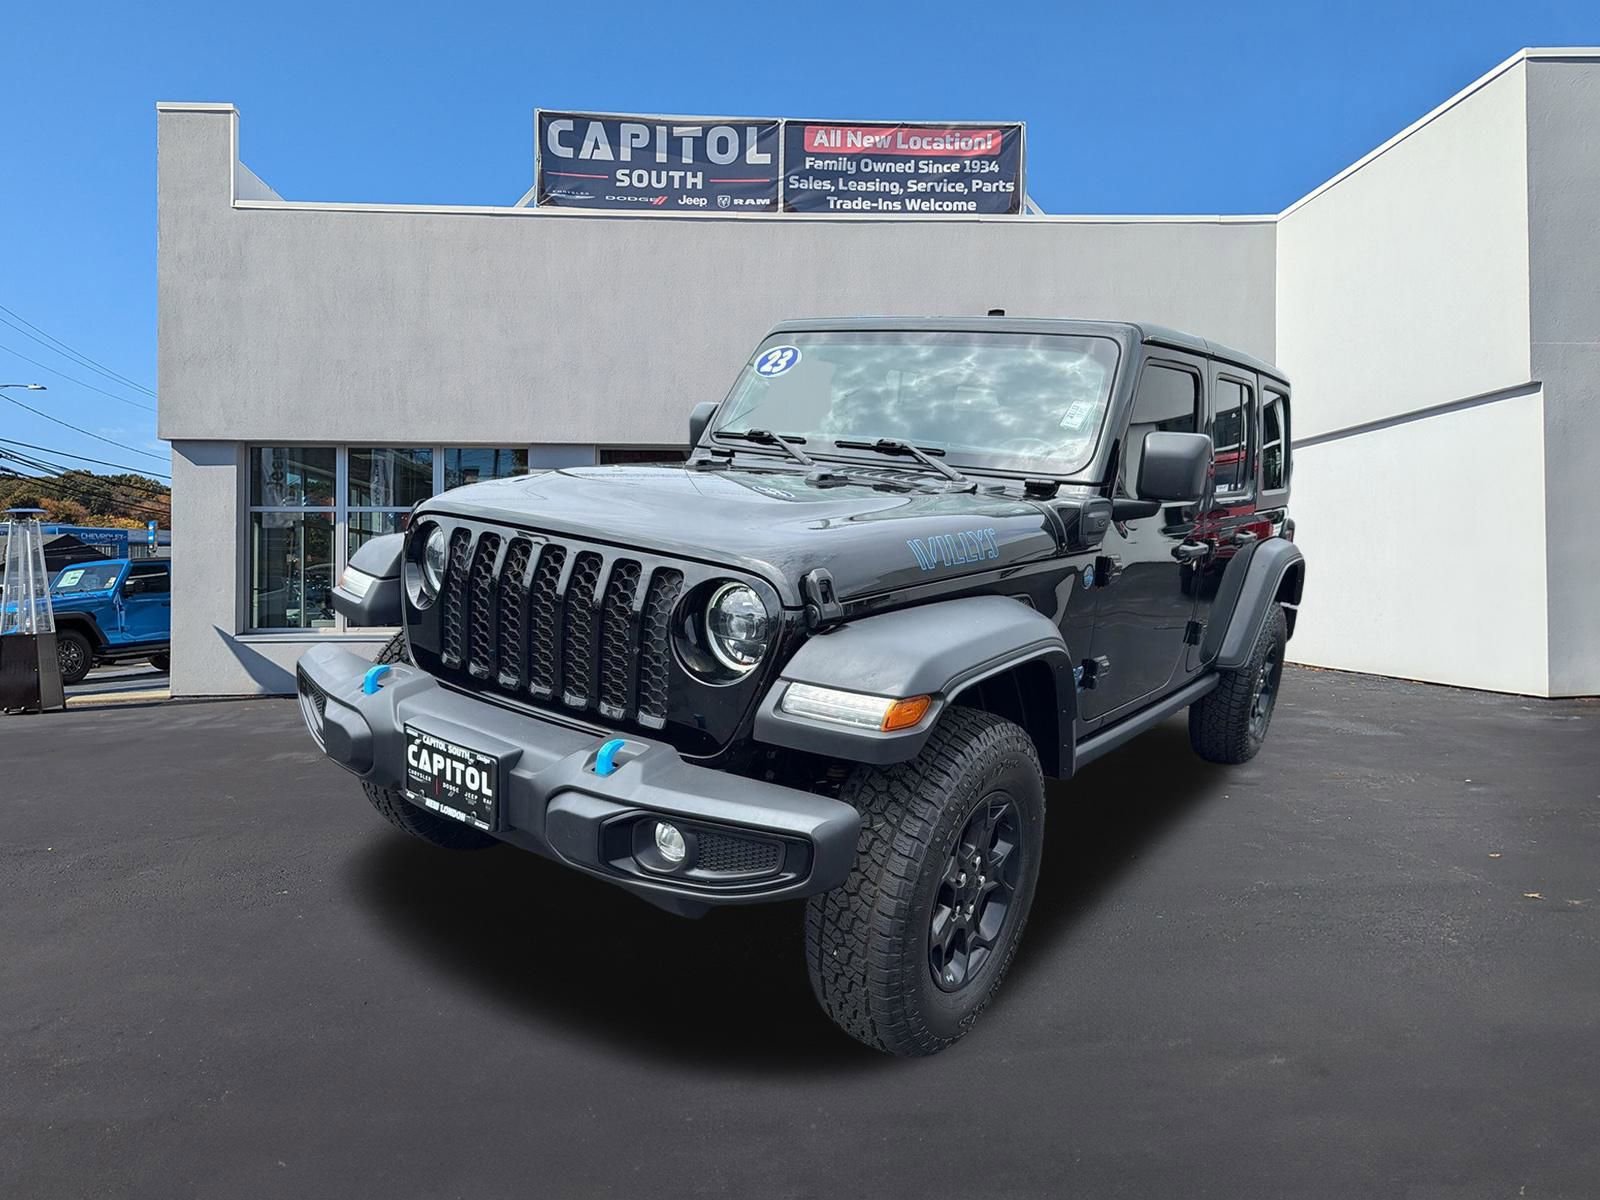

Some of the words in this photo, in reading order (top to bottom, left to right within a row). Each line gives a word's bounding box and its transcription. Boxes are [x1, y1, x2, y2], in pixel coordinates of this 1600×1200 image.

[547, 119, 772, 165] CAPITOL
[813, 129, 841, 147] All
[847, 131, 893, 149] New
[896, 133, 993, 151] Location!
[805, 157, 857, 174] Family
[860, 158, 915, 173] Owned
[918, 159, 961, 174] Since
[963, 160, 1000, 173] 1934
[615, 168, 703, 189] SOUTH
[788, 176, 836, 192] Sales,
[838, 178, 904, 195] Leasing,
[906, 179, 968, 195] Service,
[971, 180, 1015, 193] Parts
[678, 195, 708, 207] Jeep
[733, 198, 771, 206] RAM
[827, 196, 902, 211] Trade-Ins
[905, 197, 977, 211] Welcome
[760, 349, 794, 373] 23
[906, 527, 1000, 571] WILLYS
[422, 735, 447, 752] CAPITOL
[447, 744, 470, 760] SOUTH
[407, 743, 493, 797] CAPITOL
